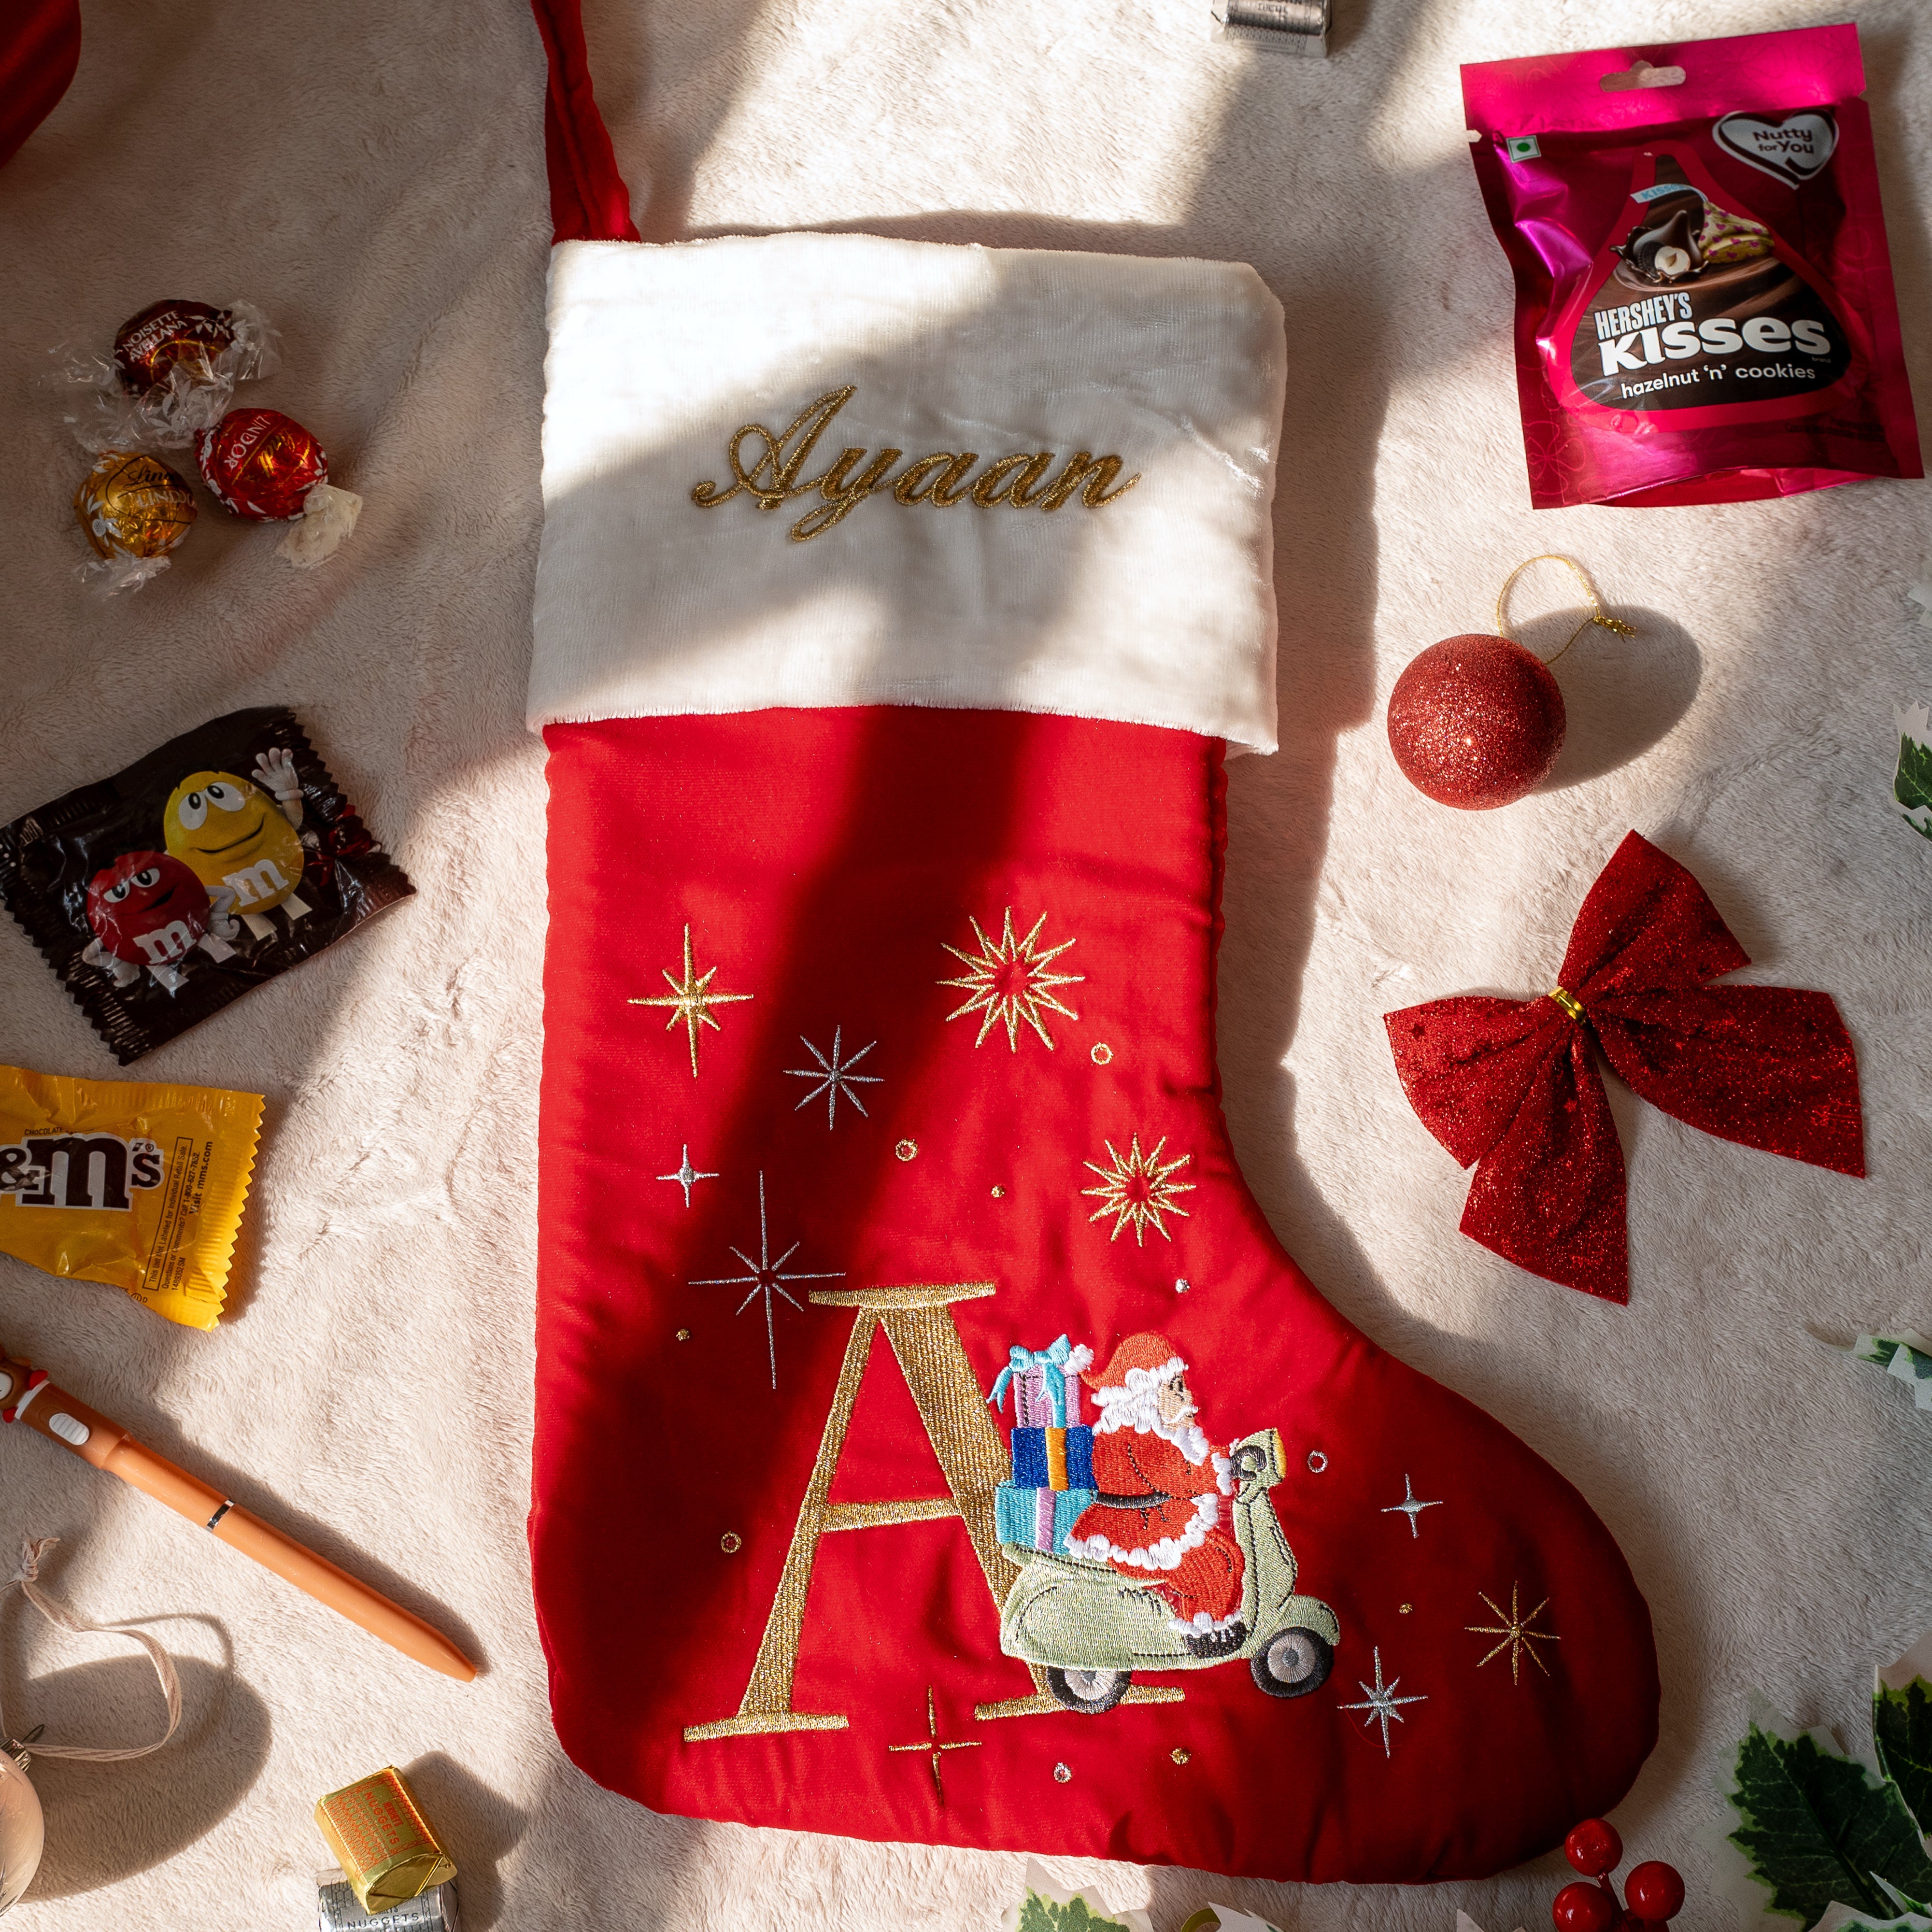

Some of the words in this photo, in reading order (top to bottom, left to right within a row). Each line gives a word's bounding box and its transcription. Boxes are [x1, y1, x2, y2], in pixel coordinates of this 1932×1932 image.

[1753, 128, 1812, 142] Nutty
[1758, 143, 1777, 152] for
[1776, 140, 1815, 154] You
[122, 310, 179, 353] NOISETTE
[1594, 291, 1693, 340] HERSHEY'S
[129, 320, 188, 362] AVELLANA
[1620, 368, 1700, 399] hazelnut
[1735, 364, 1816, 379] cookies
[223, 415, 271, 471] LINDOR
[691, 385, 1142, 542] Ayaan
[222, 859, 289, 907] m
[133, 920, 196, 964] m
[24, 1127, 63, 1136] CHOCOLATE
[173, 1161, 184, 1179] Retail
[188, 1192, 202, 1214] Visit
[197, 1141, 213, 1190] mms.com
[169, 1180, 180, 1209] Individual
[165, 1210, 174, 1219] for
[159, 1220, 172, 1245] Labeled
[161, 1261, 175, 1289] Questions
[171, 1217, 186, 1253] Comments?
[180, 1203, 188, 1216] Call
[153, 1256, 161, 1268] Unit
[155, 1246, 165, 1257] Not
[149, 1269, 158, 1282] This
[684, 1280, 1186, 1742] A
[363, 1791, 400, 1845] NUGGETS
[347, 1912, 420, 1930] NUGGETS
